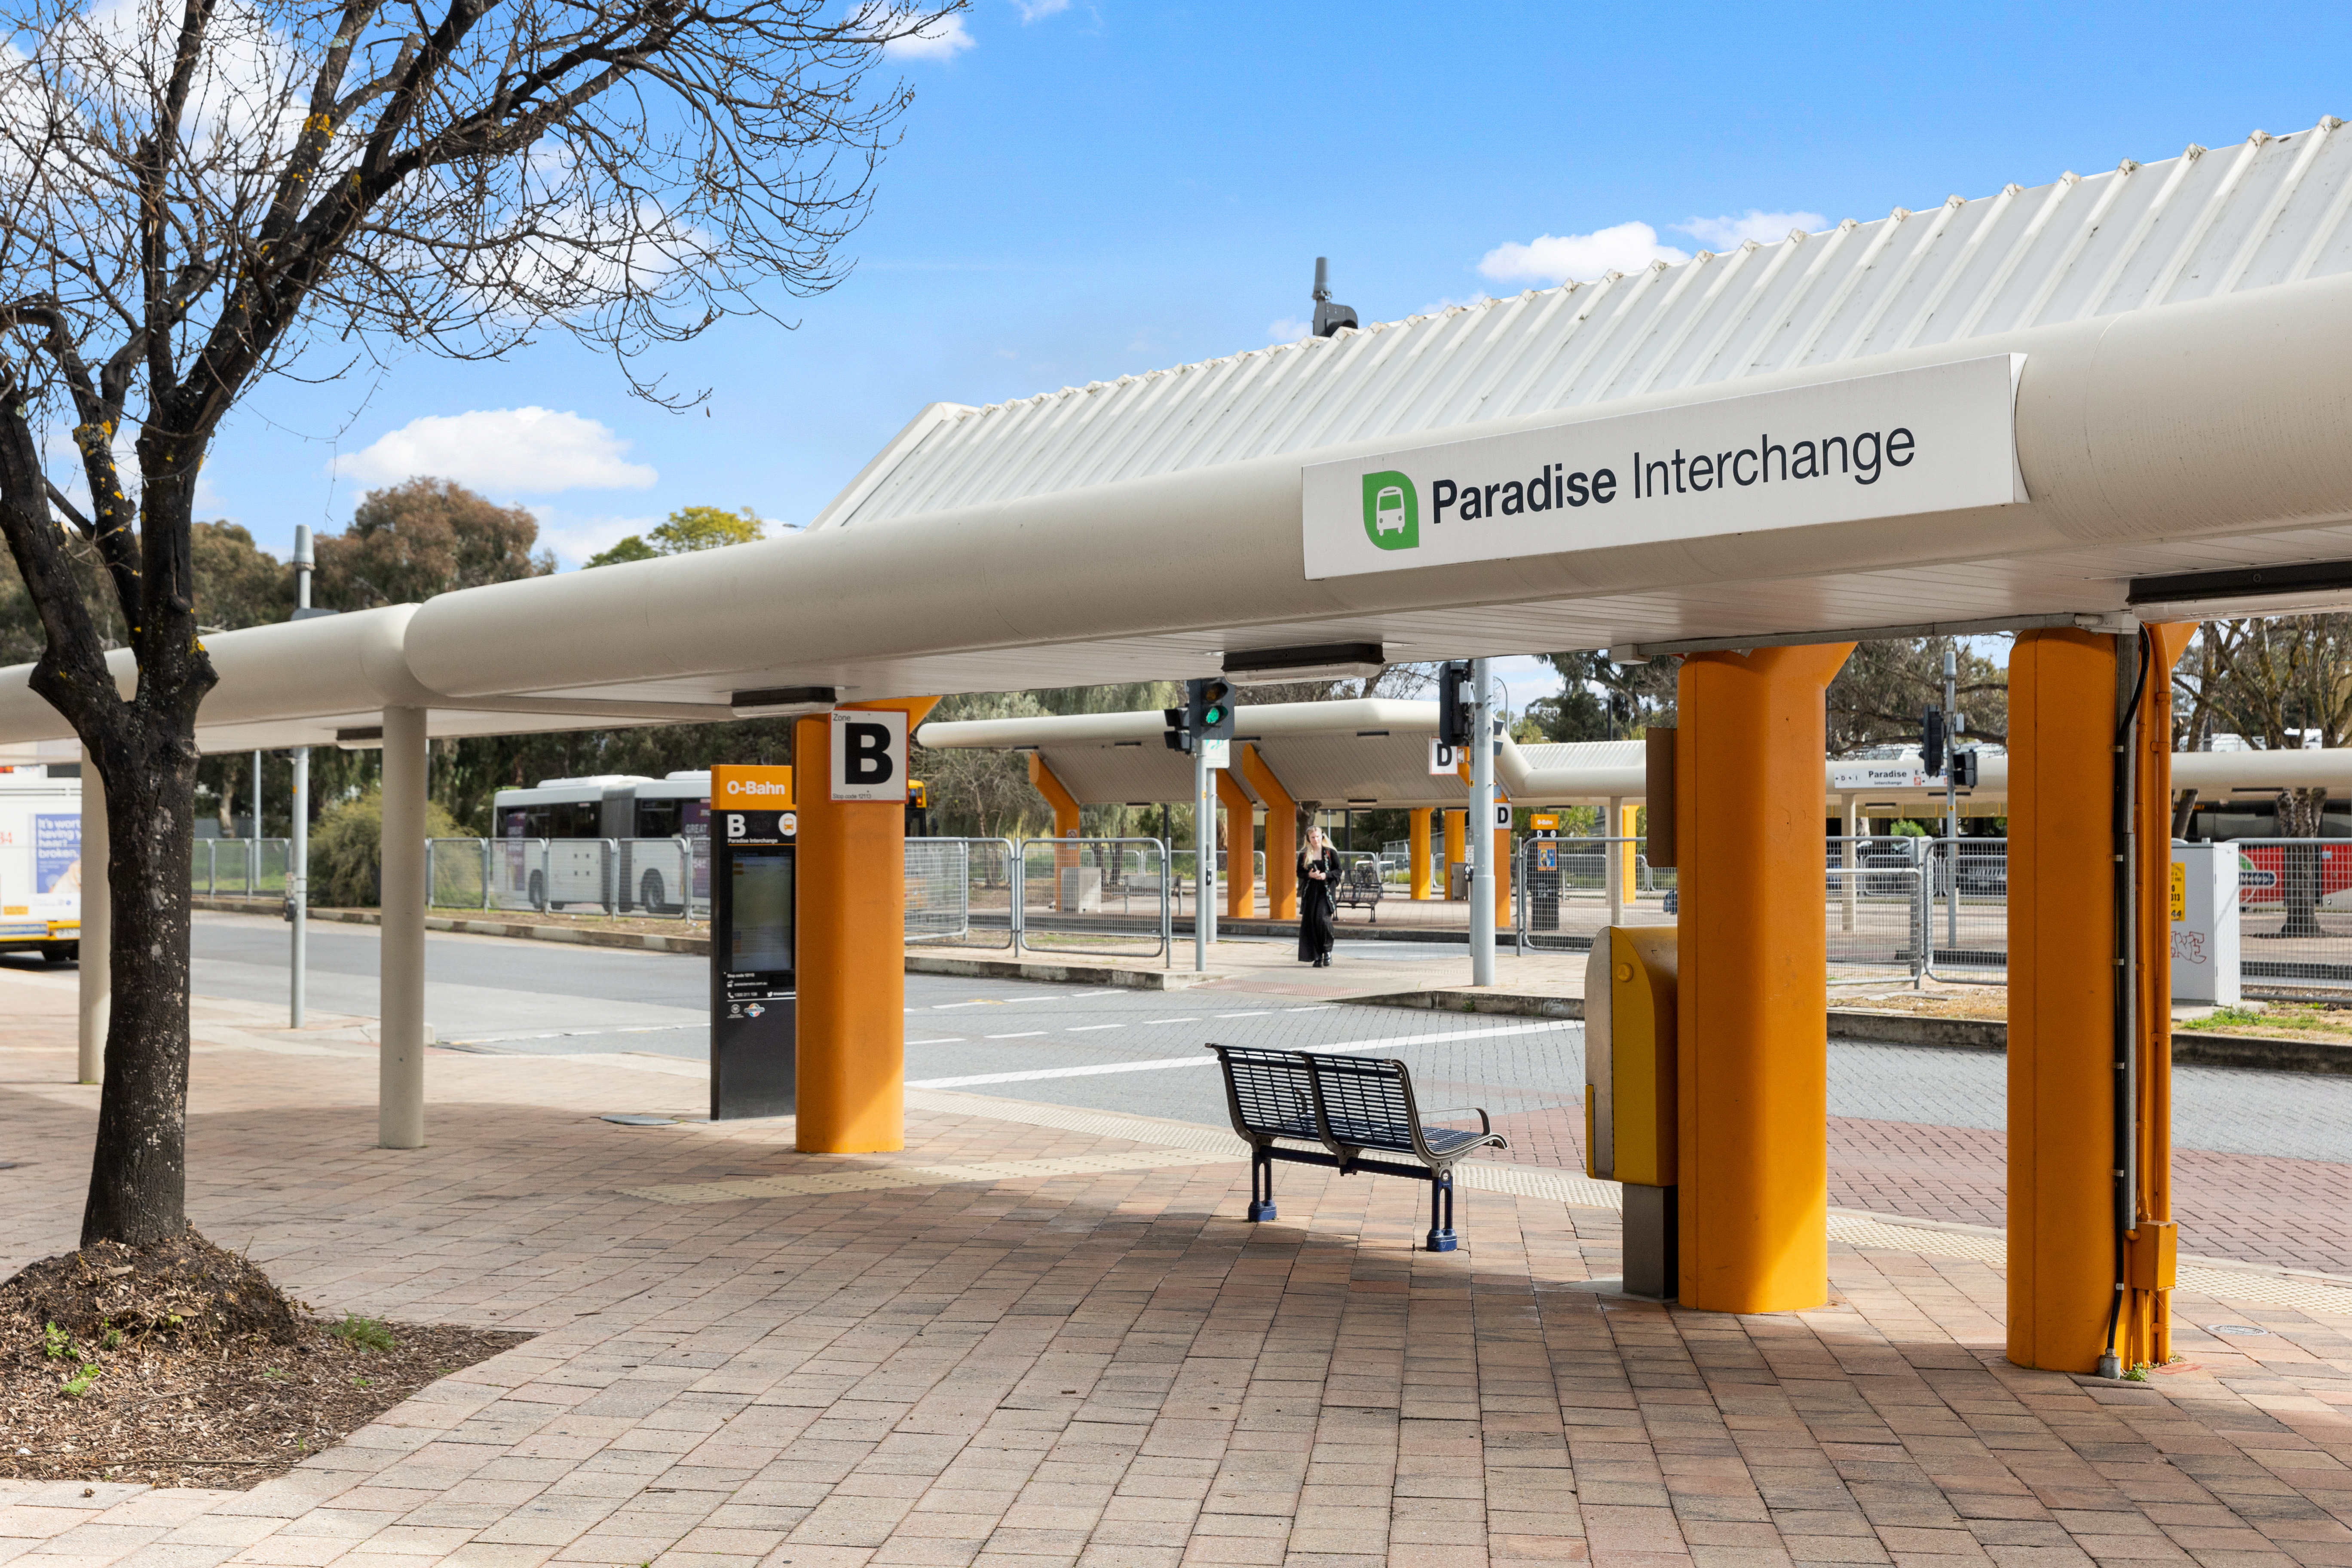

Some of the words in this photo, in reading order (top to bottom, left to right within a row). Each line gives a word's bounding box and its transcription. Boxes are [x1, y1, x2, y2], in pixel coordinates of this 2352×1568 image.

[1433, 463, 1617, 524] Paradise
[1634, 427, 1915, 499] Interchange
[845, 723, 893, 784] B
[1437, 743, 1452, 766] D
[727, 780, 785, 795] O-Bahn
[1497, 806, 1509, 824] D
[37, 818, 53, 829] It's
[54, 819, 81, 829] wort
[727, 814, 746, 838] B
[38, 829, 74, 840] having
[1537, 830, 1543, 839] D
[38, 839, 67, 848] heart
[2240, 874, 2268, 883] Metro
